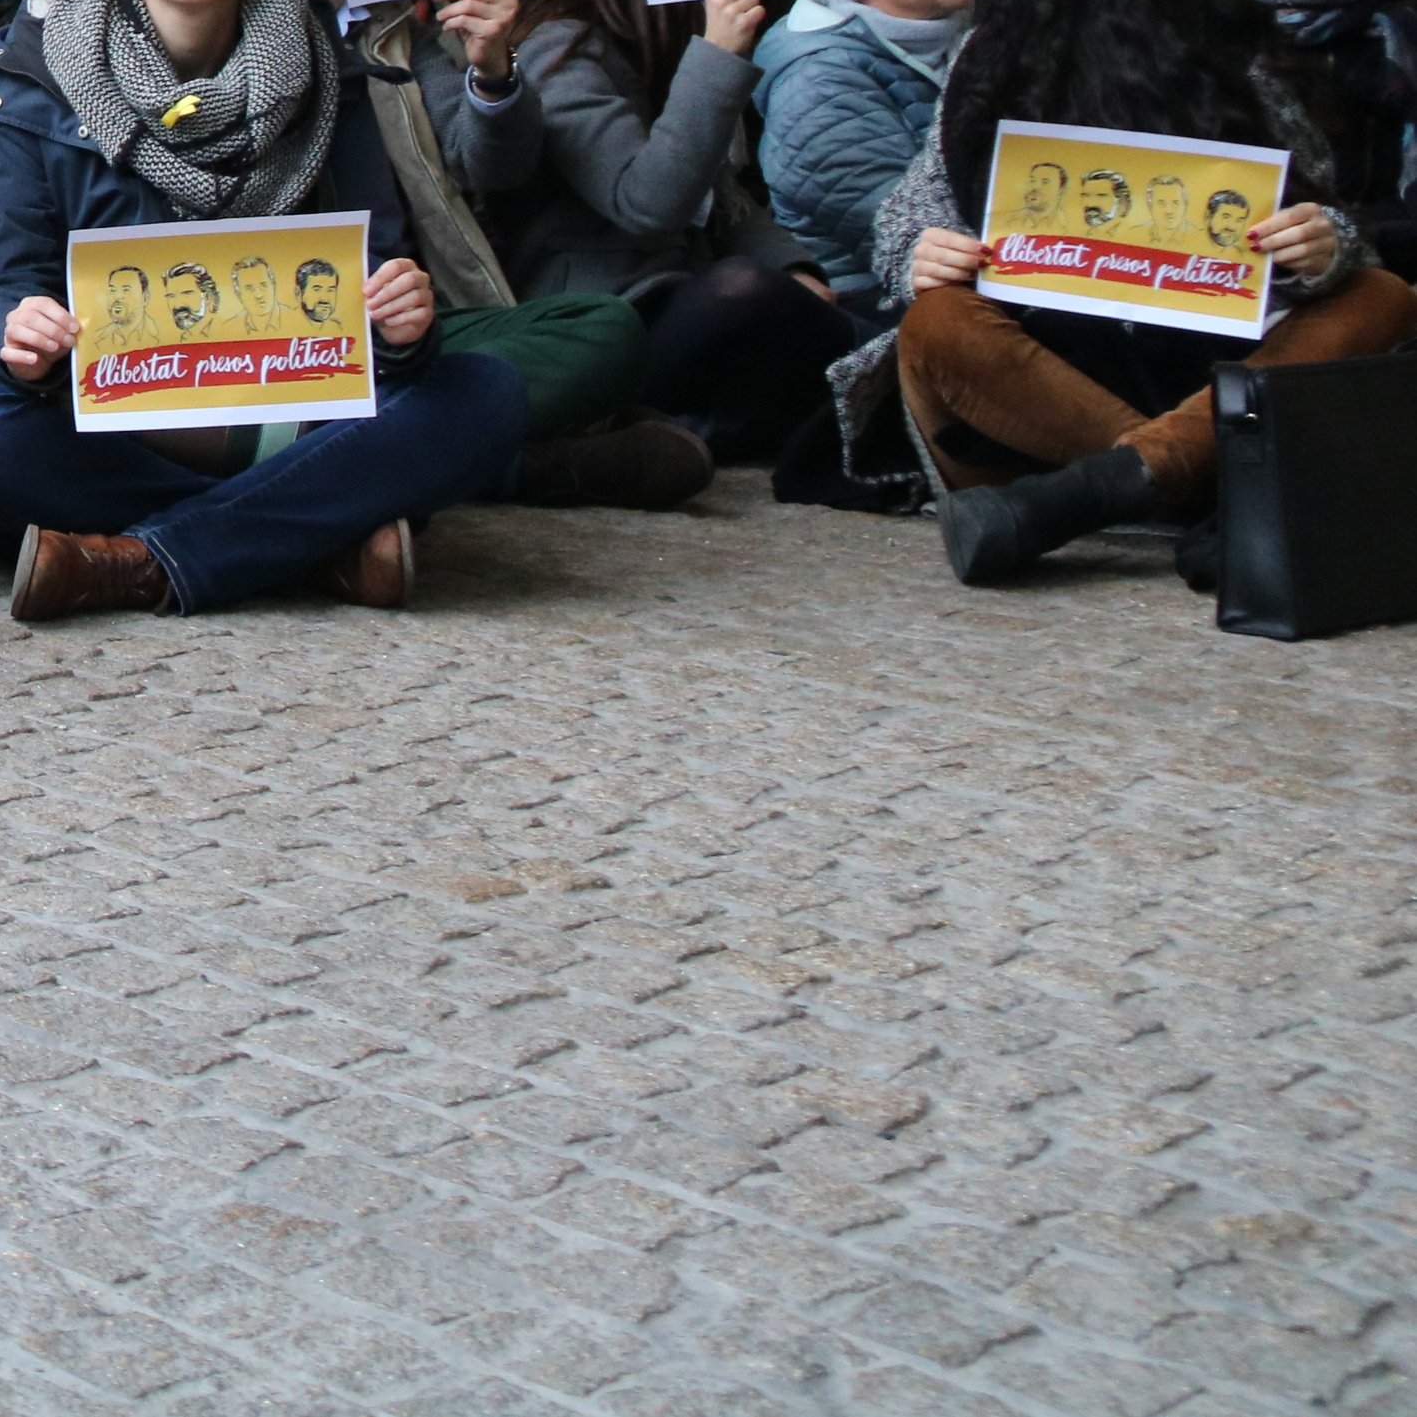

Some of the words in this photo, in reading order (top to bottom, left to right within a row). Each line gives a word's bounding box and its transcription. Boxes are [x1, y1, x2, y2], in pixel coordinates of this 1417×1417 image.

[999, 233, 1092, 267] llibertat
[1091, 252, 1152, 279] presos
[93, 350, 189, 389] llibertat
[194, 353, 255, 387] presos
